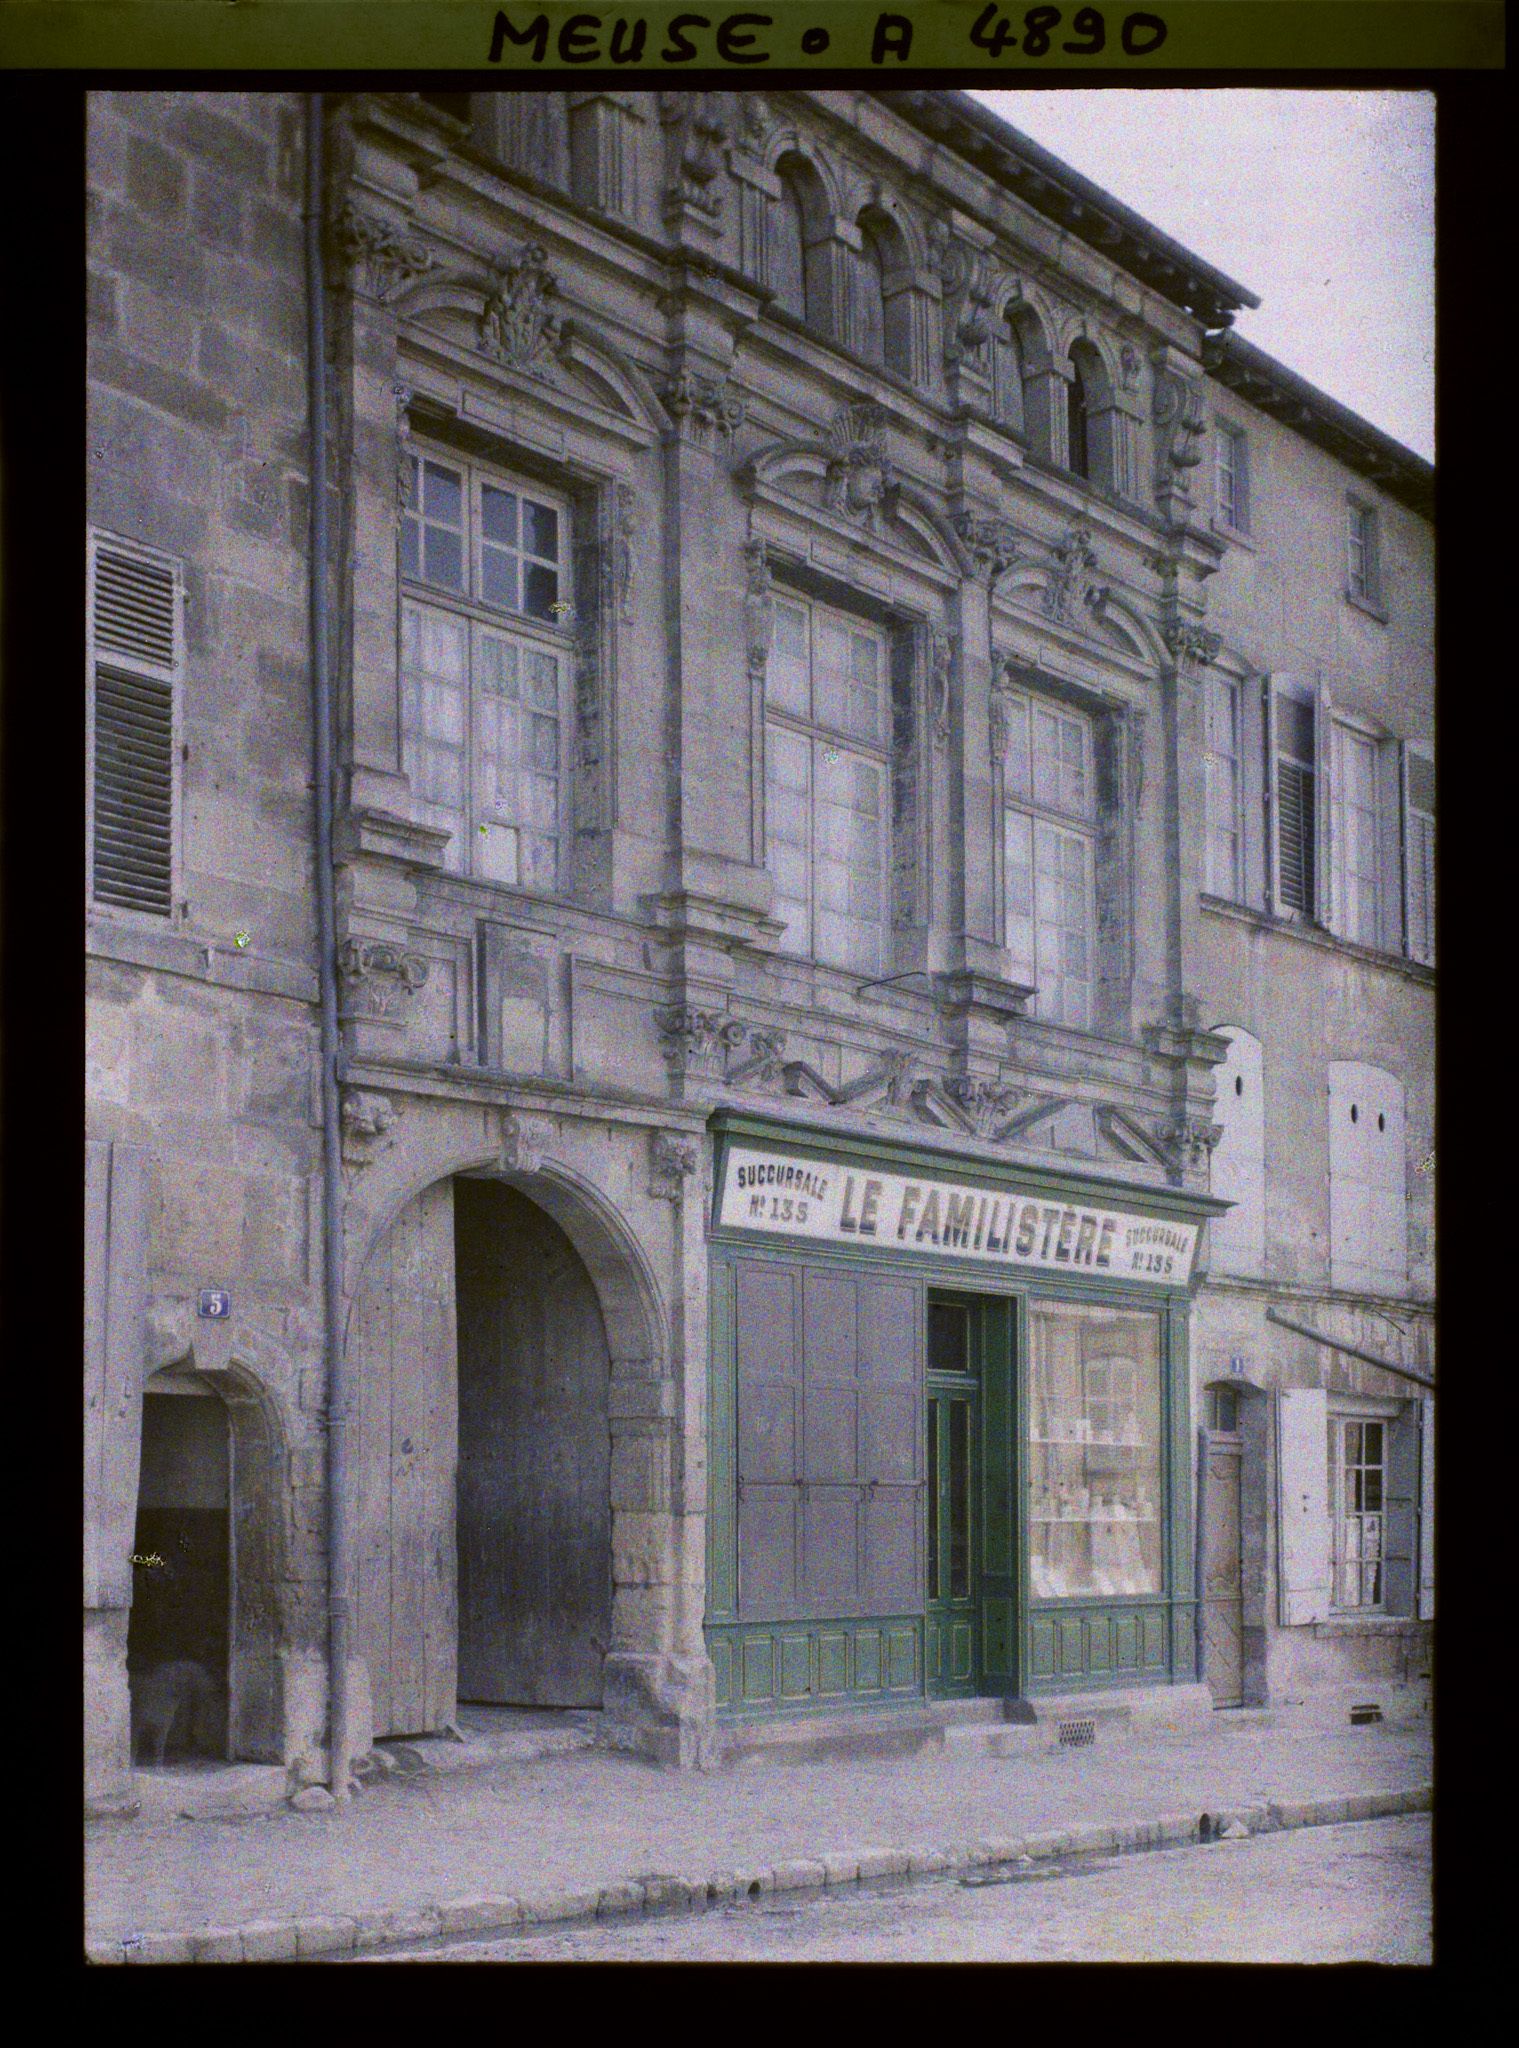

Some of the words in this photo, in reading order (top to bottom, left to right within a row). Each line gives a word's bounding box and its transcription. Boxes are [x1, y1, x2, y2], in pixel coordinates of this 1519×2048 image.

[488, 11, 773, 63] MEUSE
[871, 12, 913, 64] A
[970, 2, 1167, 57] 4890
[737, 1164, 828, 1201] SUCCURSALE
[770, 1197, 808, 1223] 135
[840, 1176, 883, 1235] LE
[897, 1186, 1117, 1267] FAMILISTÈRE
[1126, 1226, 1188, 1253] SUCCURSALE
[1146, 1254, 1173, 1274] 135
[209, 1293, 222, 1315] 5
